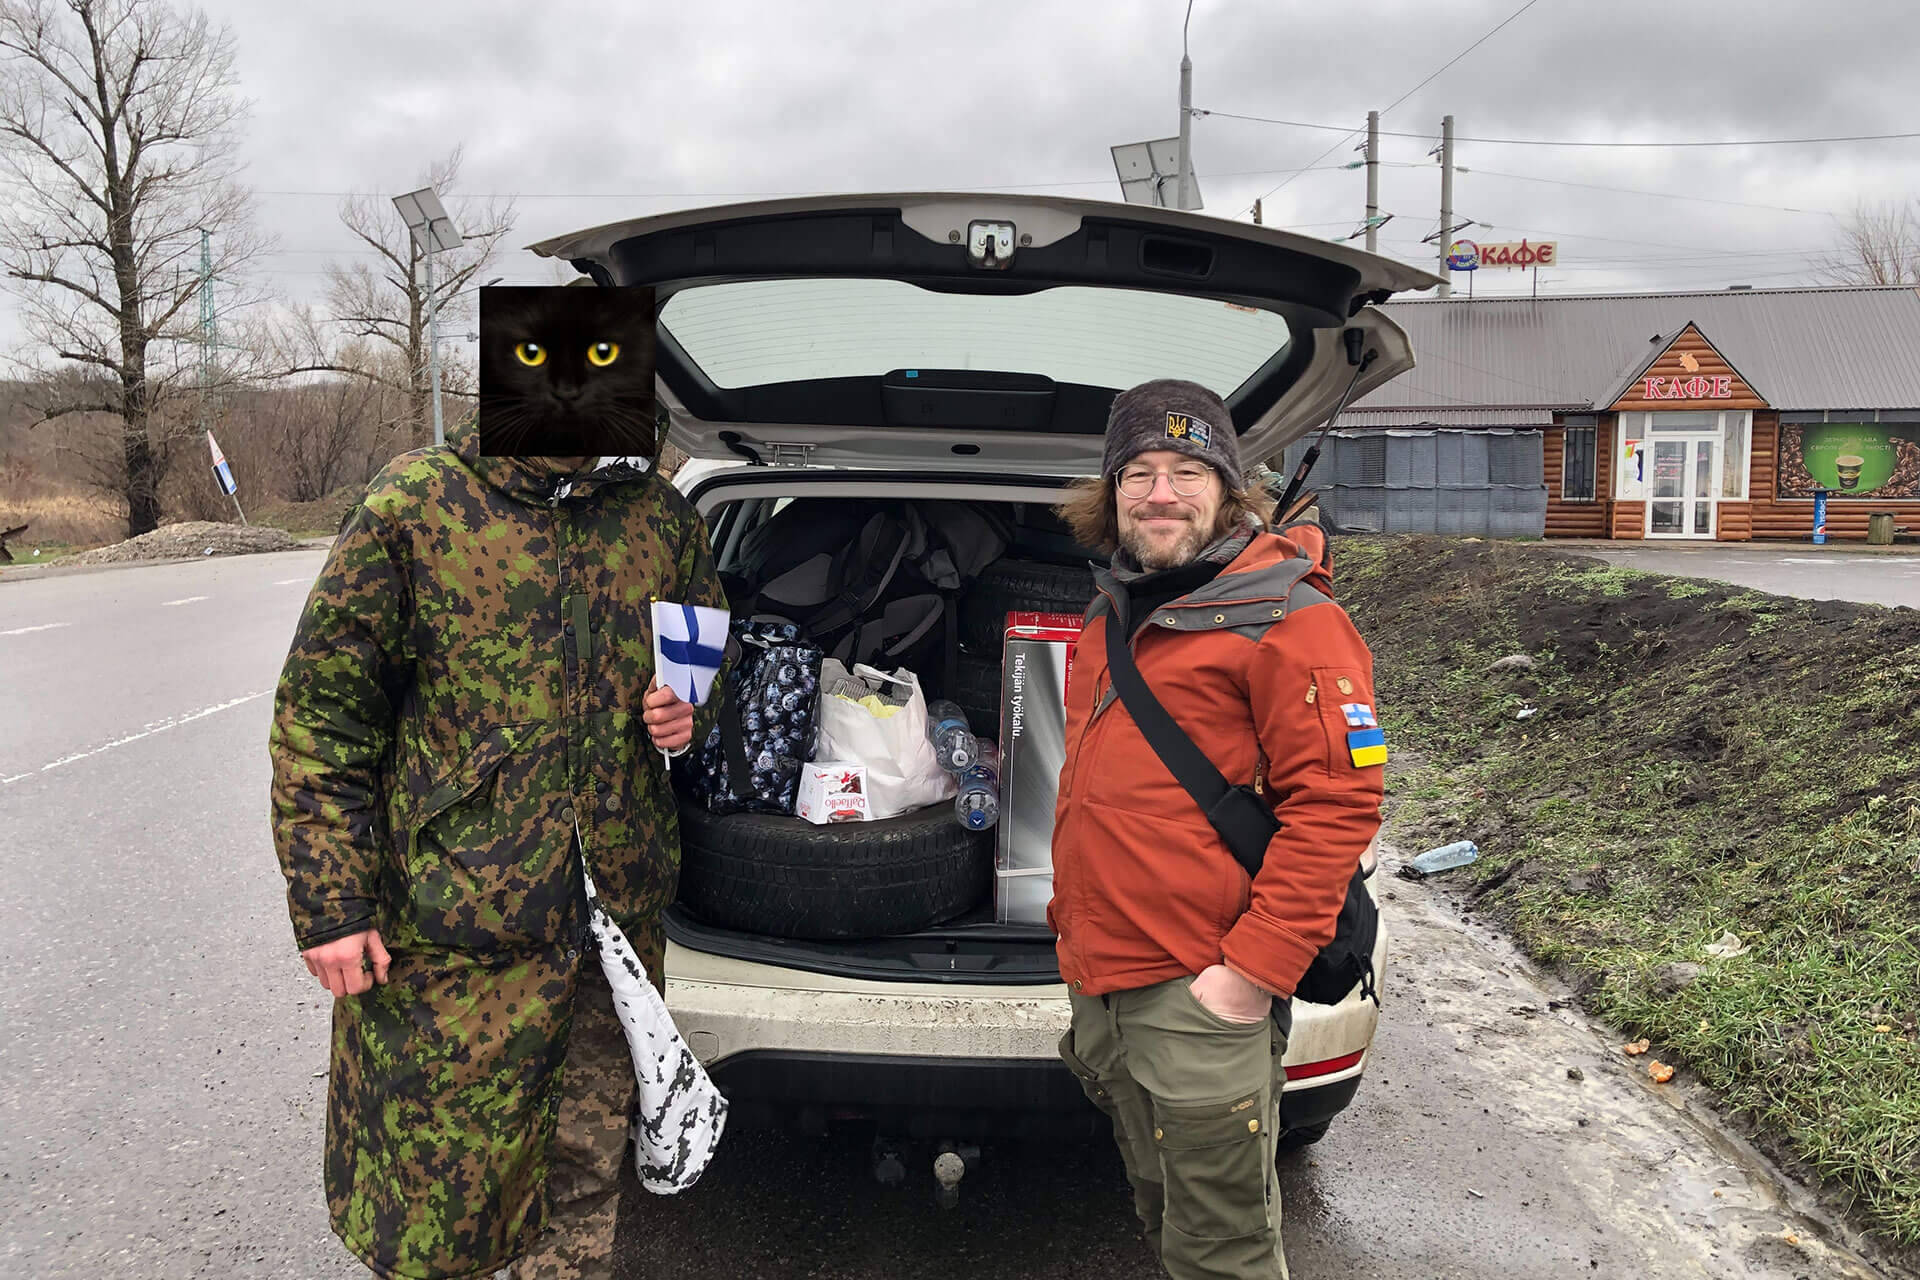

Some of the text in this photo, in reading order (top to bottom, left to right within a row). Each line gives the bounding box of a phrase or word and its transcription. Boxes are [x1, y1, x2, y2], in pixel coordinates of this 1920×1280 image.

[1643, 376, 1732, 399] КАФЕ
[1010, 652, 1026, 740] Tekijän työkalu.
[824, 796, 866, 809] Raffaello
